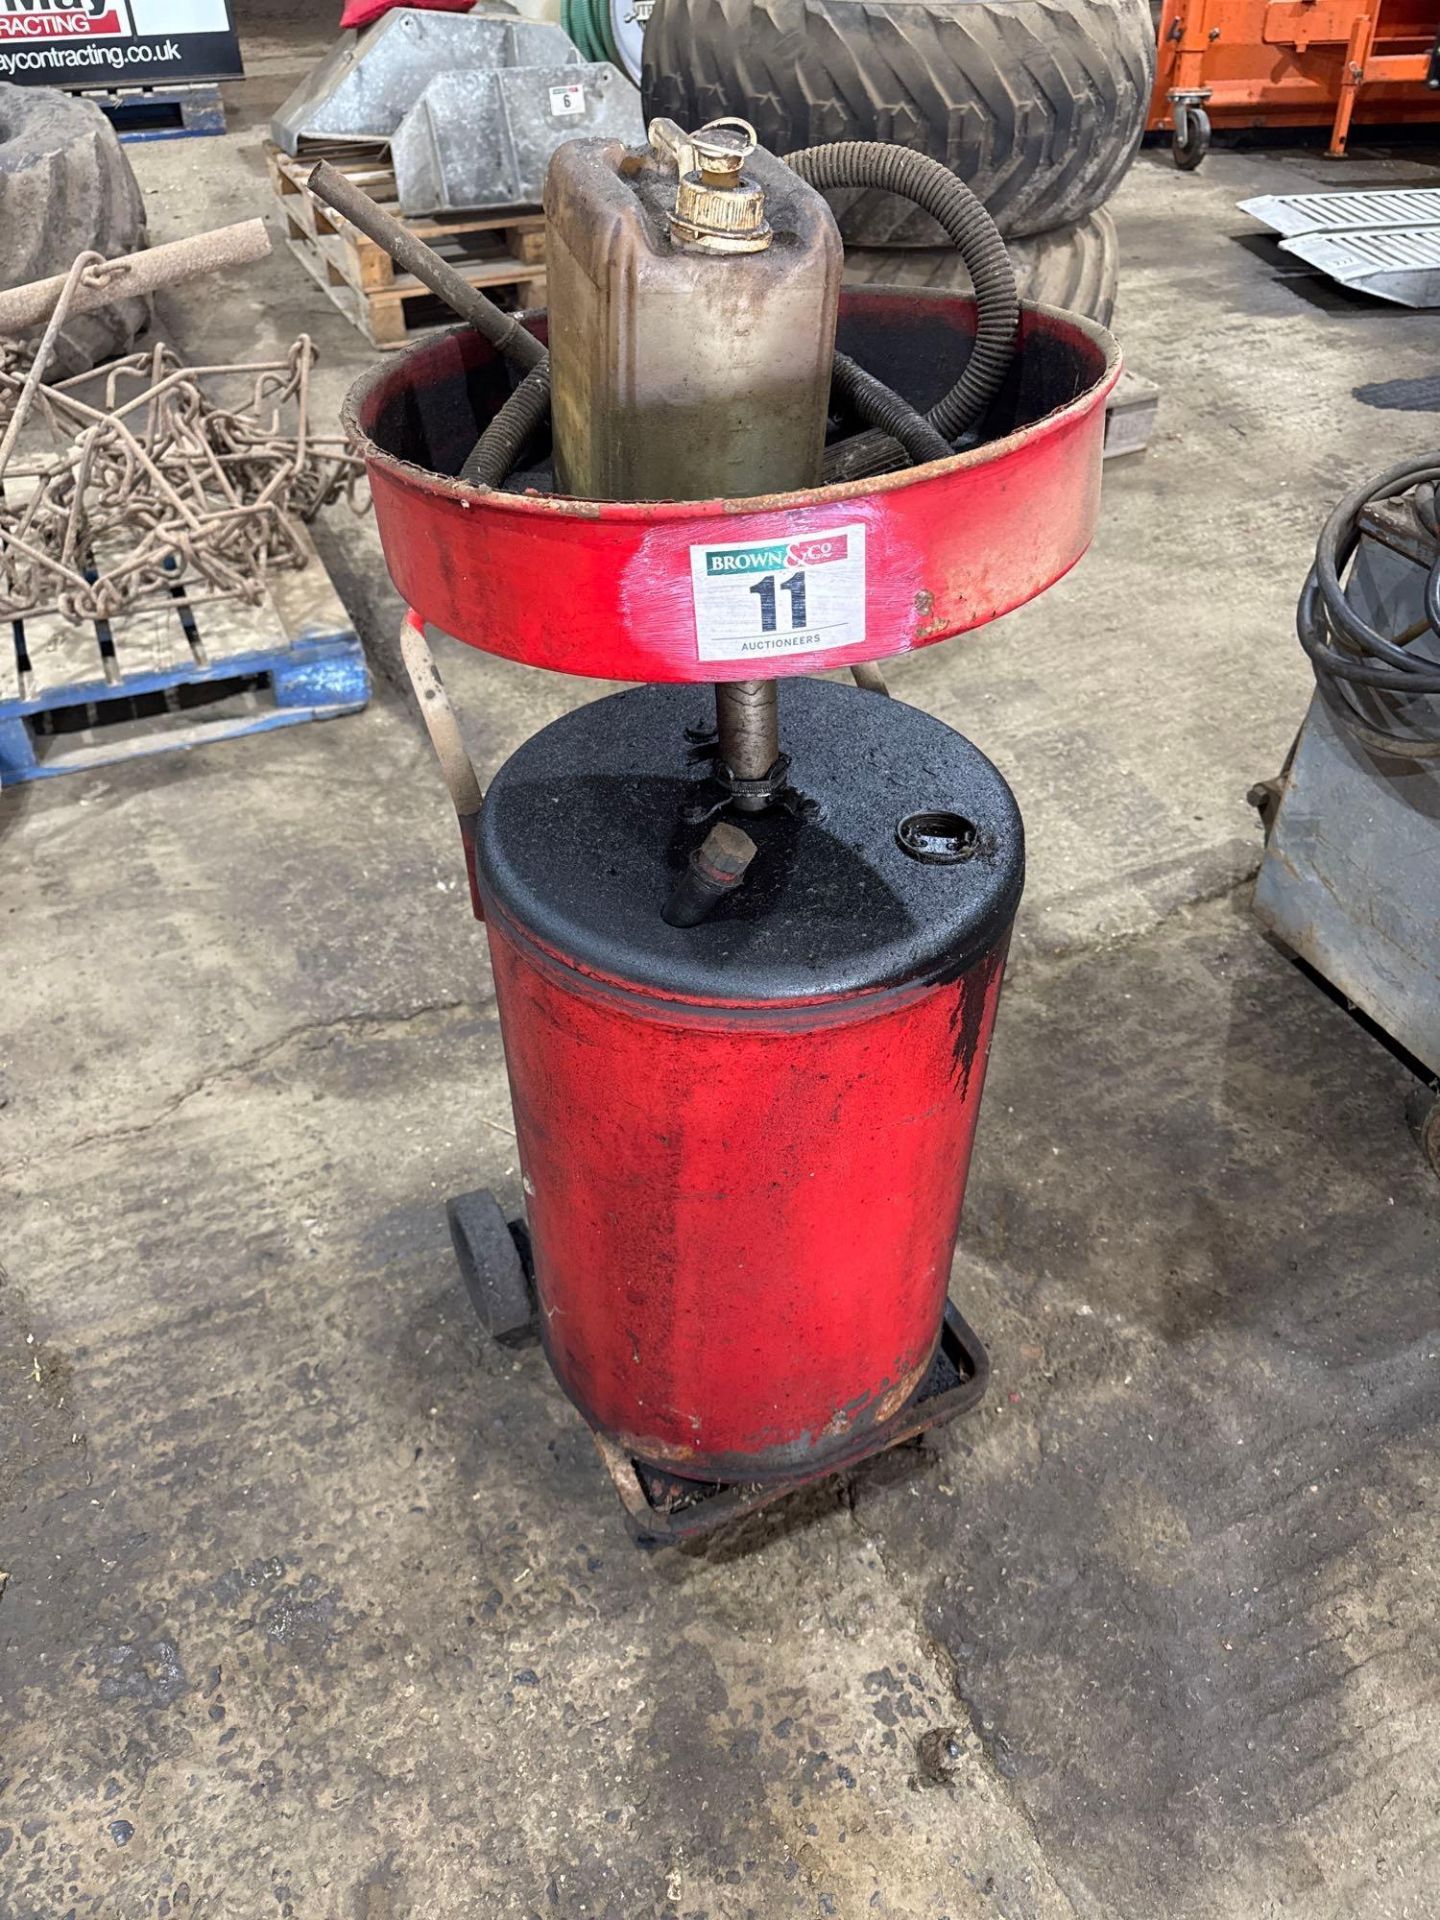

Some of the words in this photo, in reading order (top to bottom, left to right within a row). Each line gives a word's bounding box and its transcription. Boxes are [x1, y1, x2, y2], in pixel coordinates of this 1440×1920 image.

[0, 14, 90, 36] RACTING
[563, 94, 571, 108] 6
[750, 571, 806, 632] 11
[741, 634, 821, 651] AUCTIONEERS
